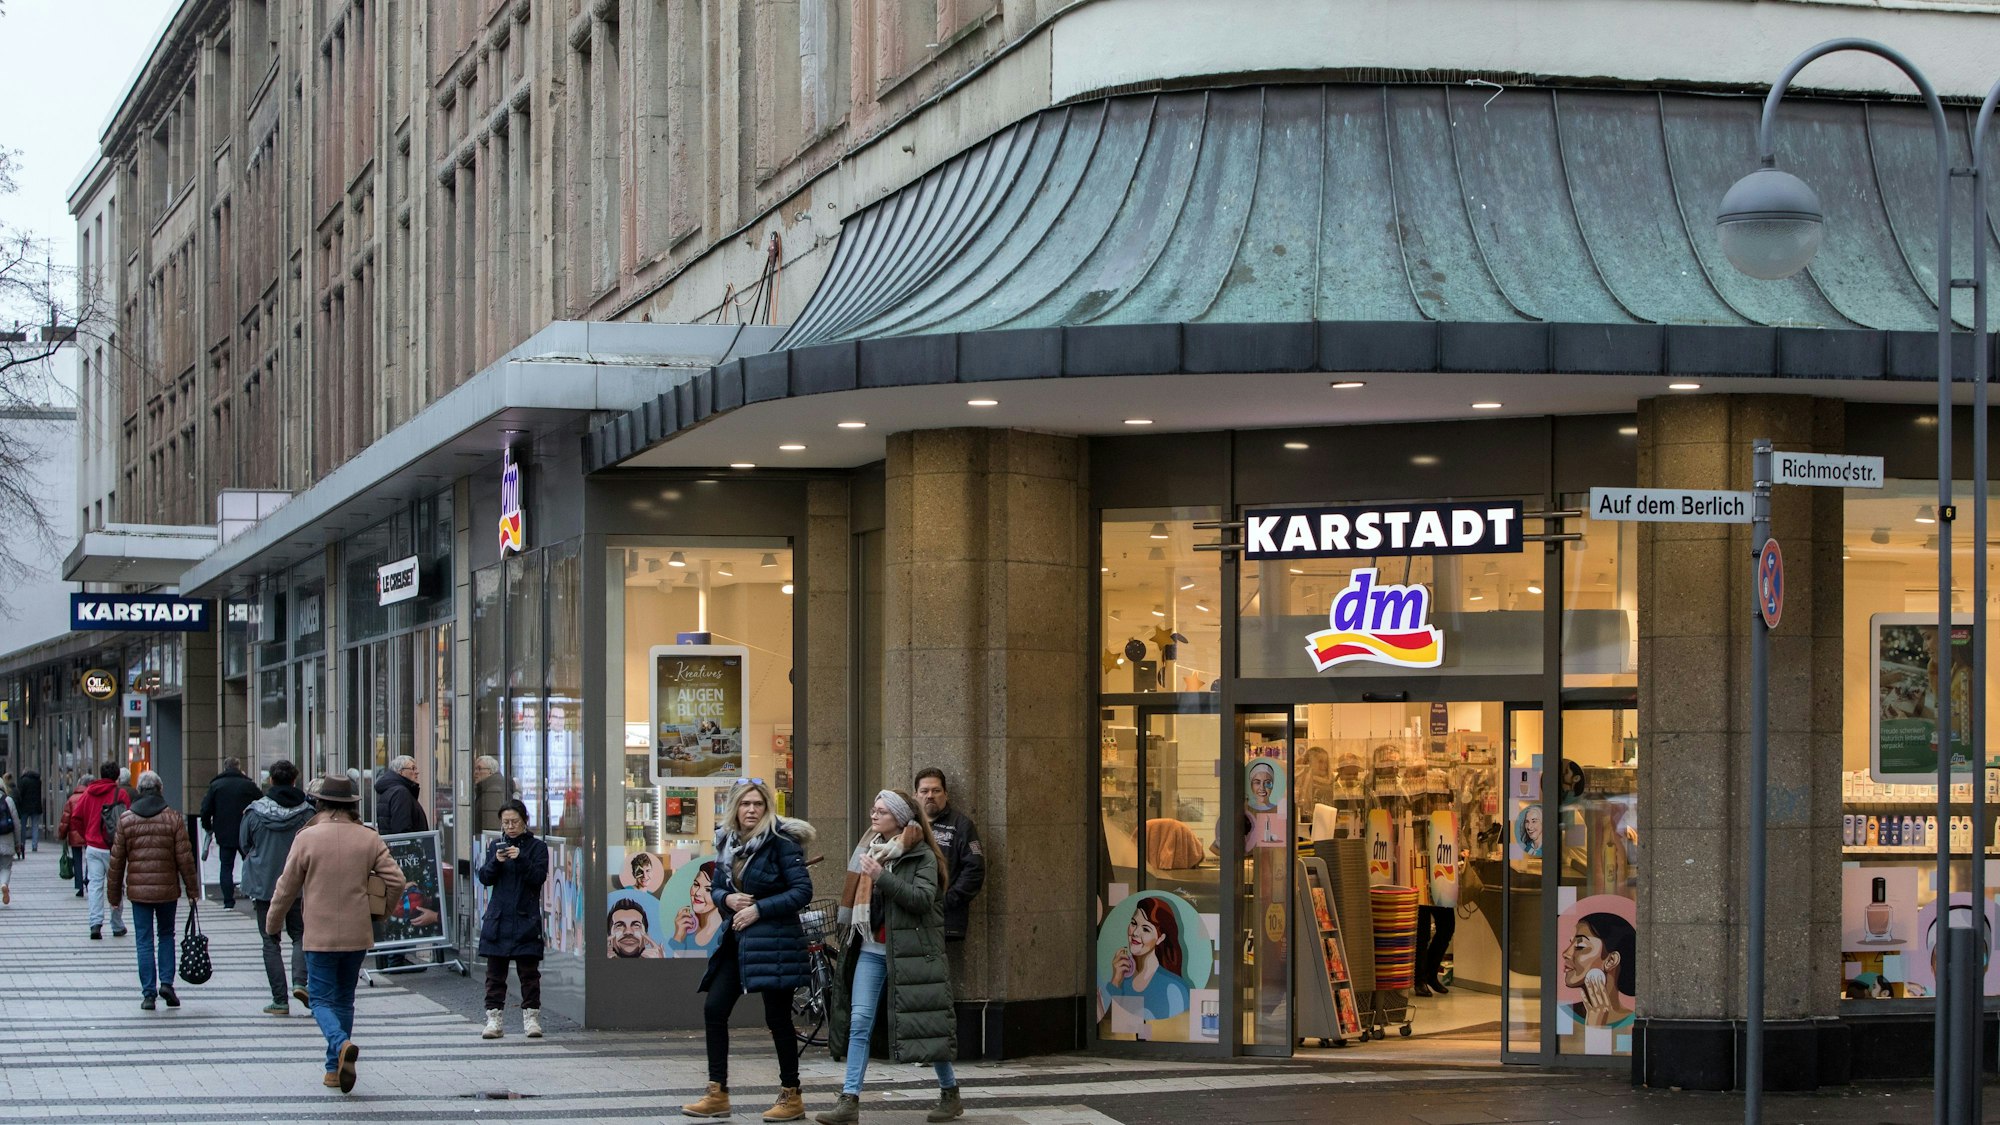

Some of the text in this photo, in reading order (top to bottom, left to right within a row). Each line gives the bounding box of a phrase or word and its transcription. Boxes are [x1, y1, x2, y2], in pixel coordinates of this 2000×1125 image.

[1782, 459, 1876, 482] Richmodstr.
[502, 453, 518, 516] dm
[1599, 494, 1745, 516] Auf dem Berlich
[1945, 507, 1952, 518] 6
[1246, 507, 1515, 553] KARSTADT
[382, 575, 390, 593] LE
[77, 602, 203, 622] KARSTADT
[1334, 573, 1424, 631] dm
[674, 661, 723, 681] Kreatives
[87, 677, 104, 687] OIL
[677, 688, 724, 702] AUGEN
[677, 702, 724, 717] BLICKE
[1373, 832, 1388, 861] dm
[1436, 834, 1452, 865] dm
